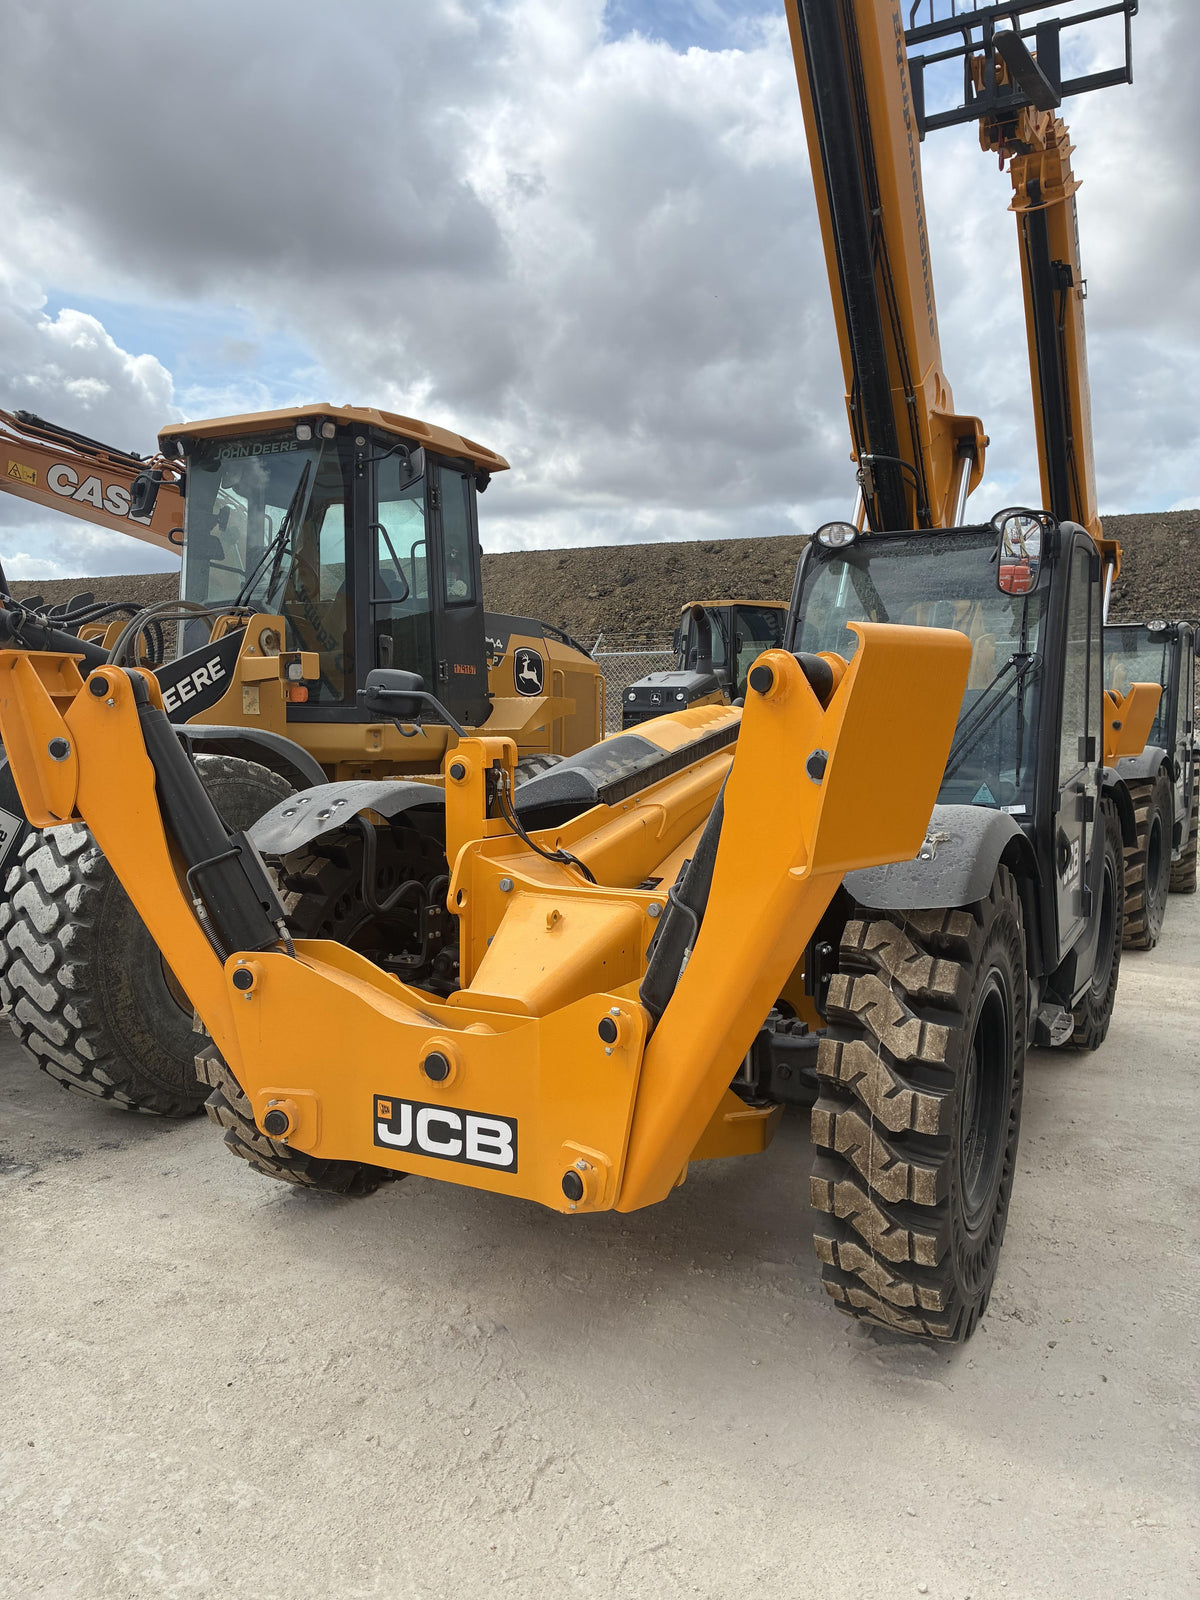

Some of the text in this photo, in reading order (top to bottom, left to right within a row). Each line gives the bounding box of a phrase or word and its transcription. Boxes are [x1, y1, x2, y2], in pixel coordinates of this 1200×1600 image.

[214, 440, 299, 460] JOHN DEERE
[161, 655, 226, 714] EERE
[377, 1103, 514, 1166] JCB
